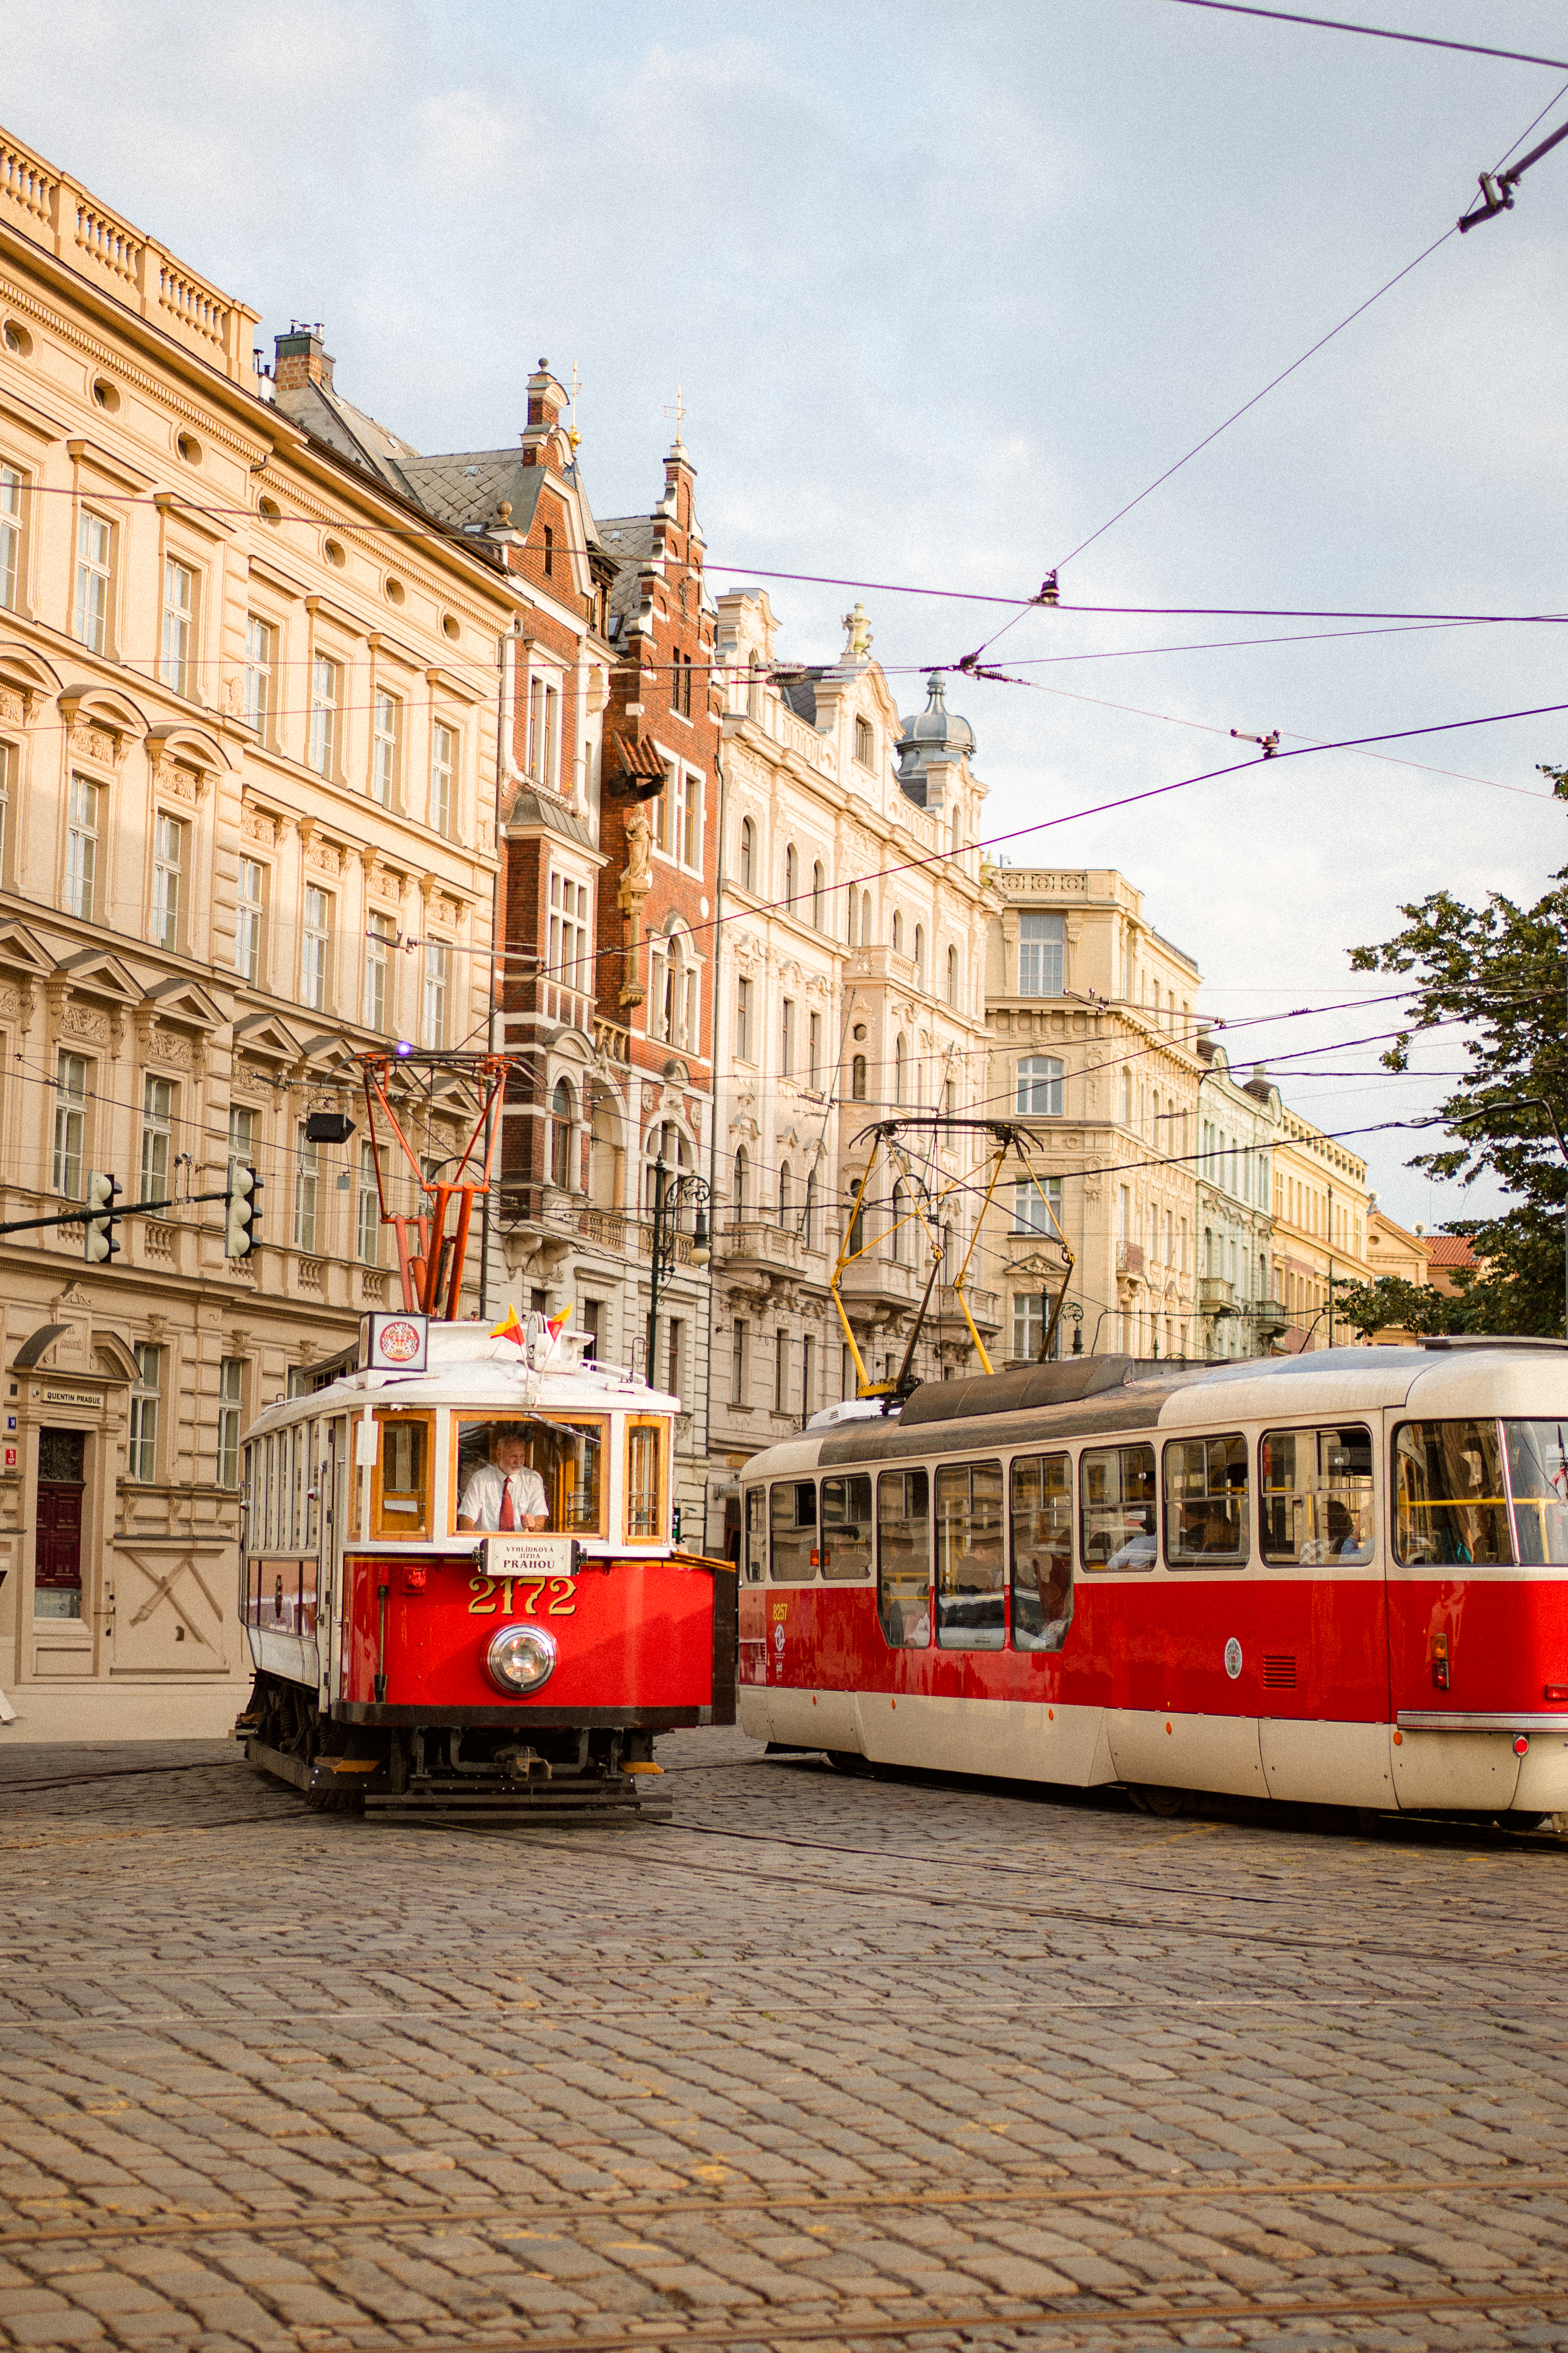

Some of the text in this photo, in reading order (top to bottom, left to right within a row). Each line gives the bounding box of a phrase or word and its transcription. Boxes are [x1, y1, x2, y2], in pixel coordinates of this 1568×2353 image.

[47, 1392, 101, 1404] QUENTIN PRAGUE
[503, 1560, 555, 1569] PRAHOU
[468, 1576, 577, 1615] 2172
[773, 1603, 788, 1620] 8257
